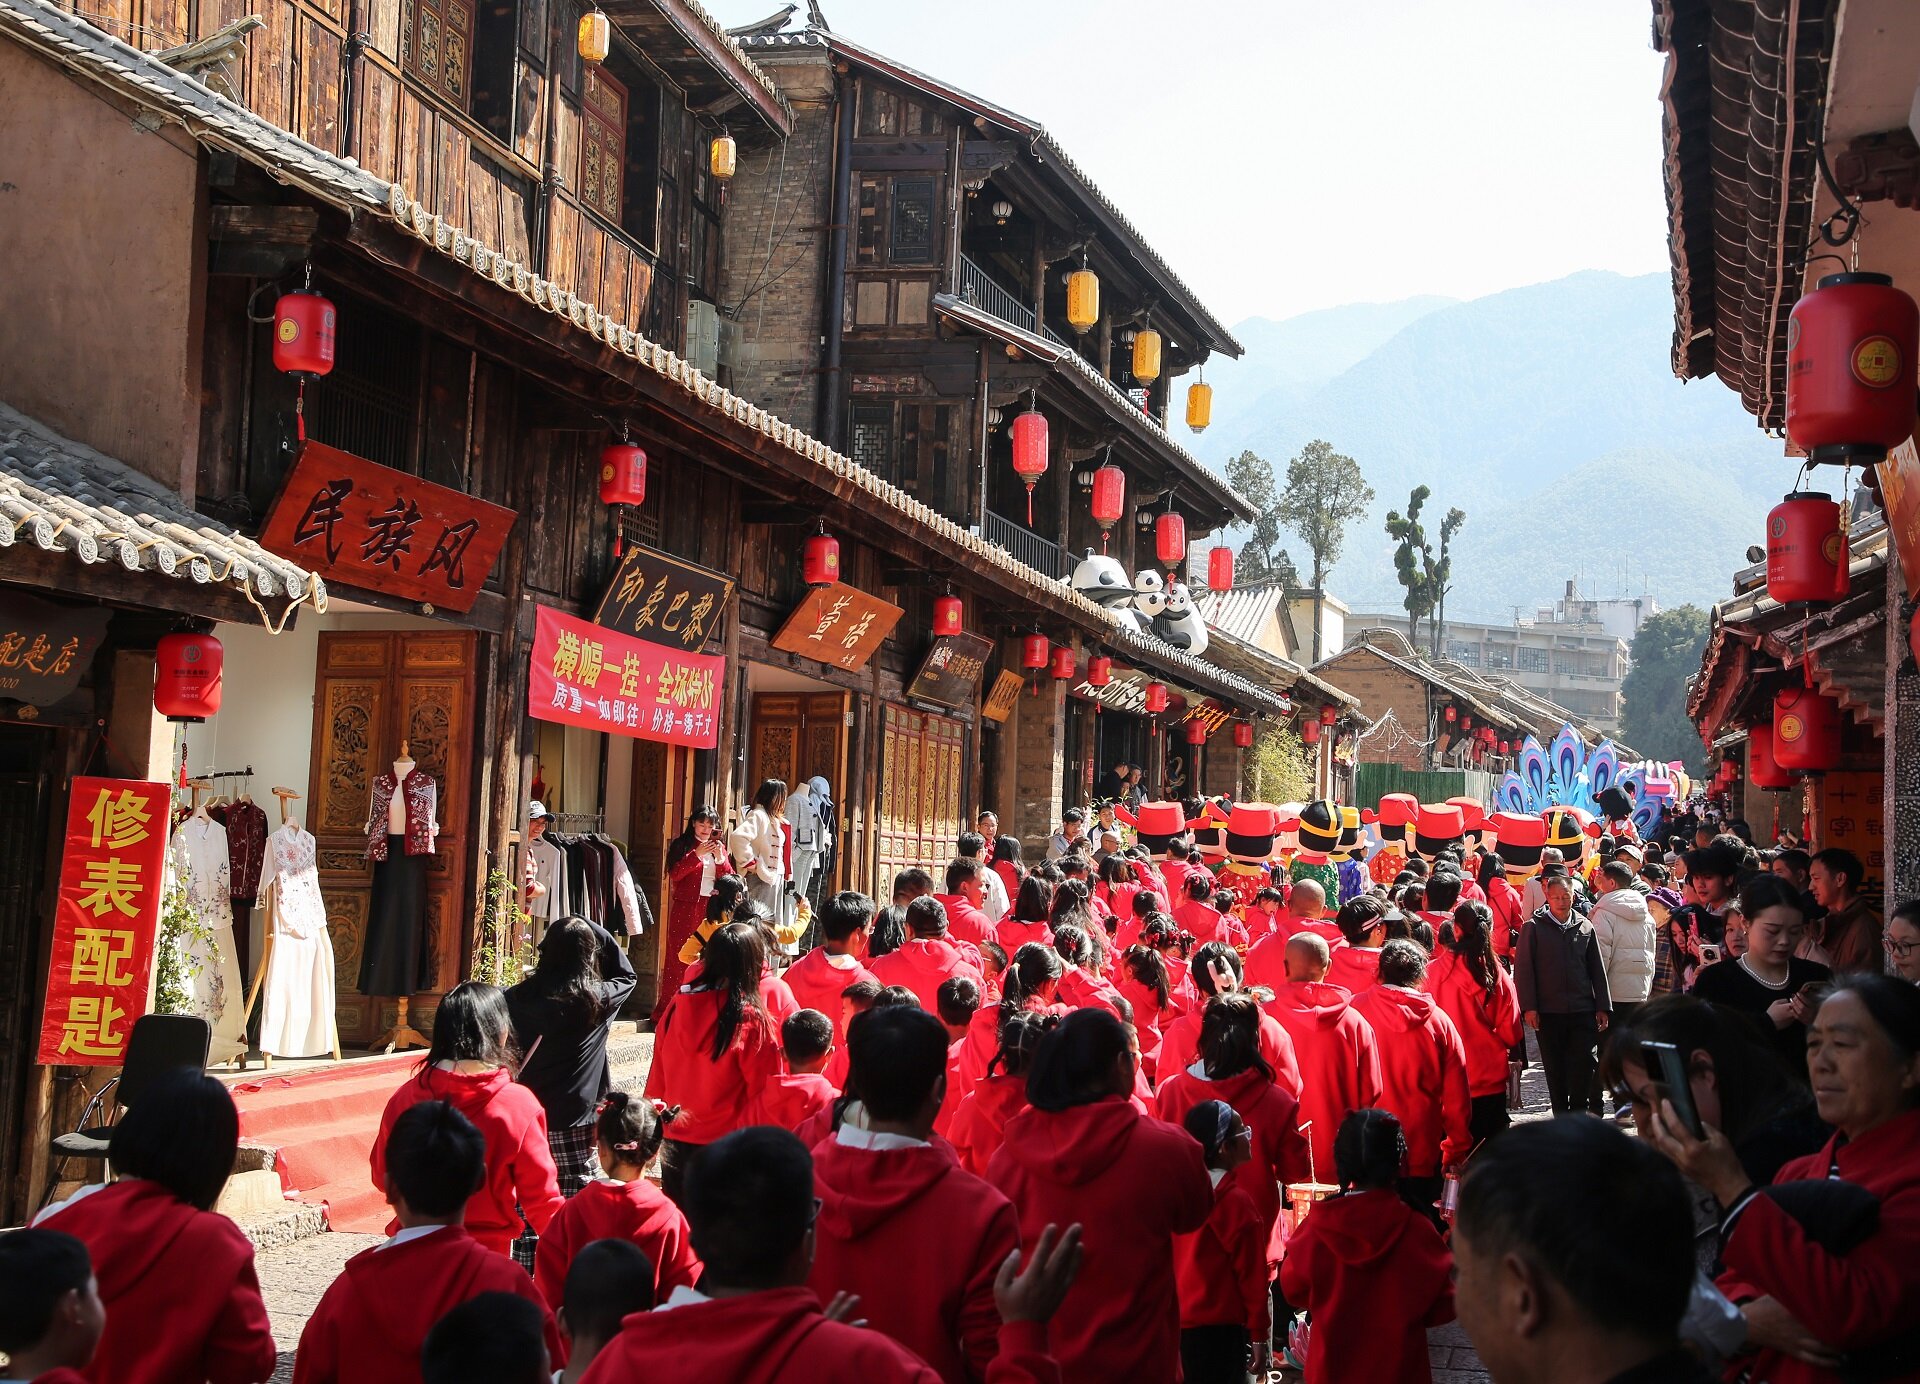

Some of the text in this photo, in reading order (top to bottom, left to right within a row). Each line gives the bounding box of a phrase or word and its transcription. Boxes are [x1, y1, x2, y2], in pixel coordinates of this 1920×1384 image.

[294, 478, 480, 590] 民族风
[615, 566, 714, 645] 印象巴黎
[57, 788, 153, 1057] 修表配匙
